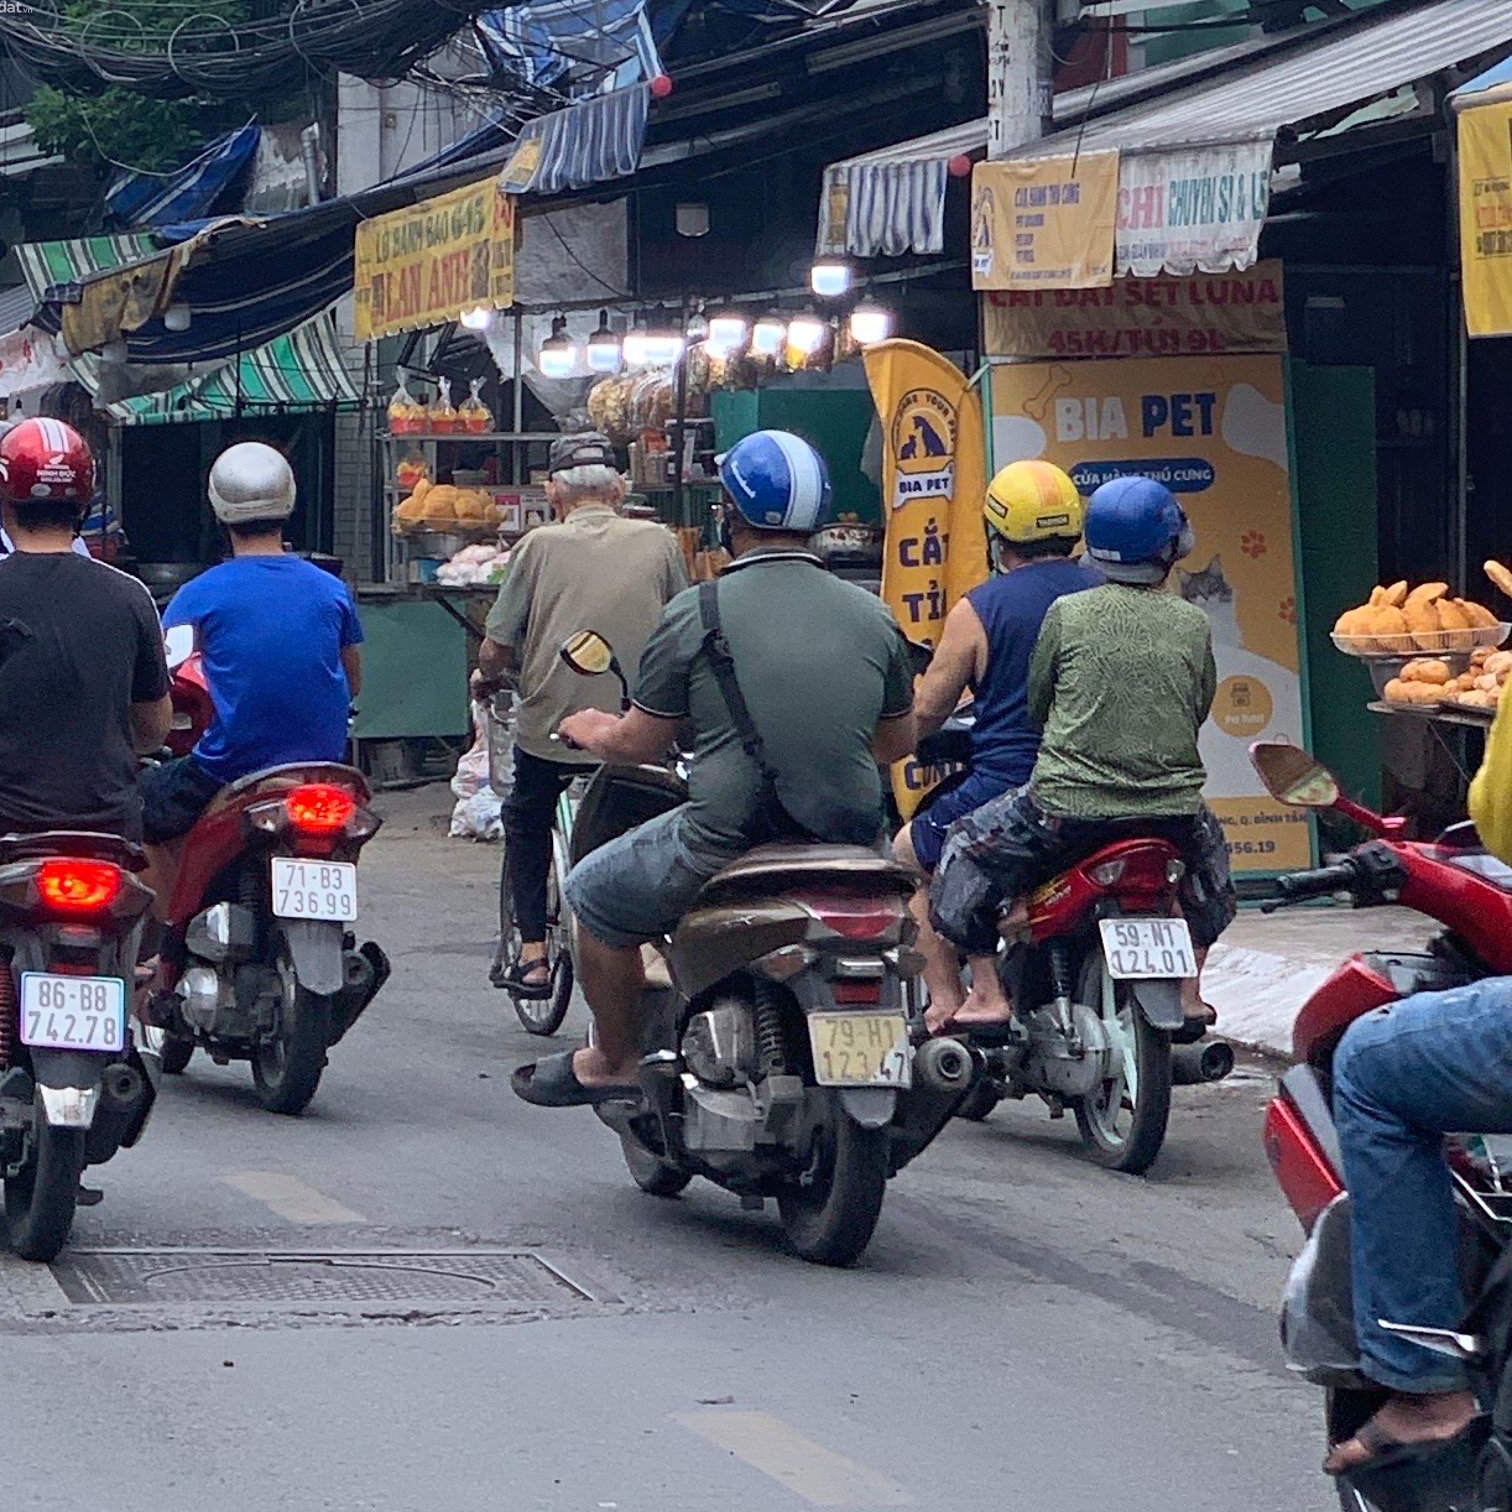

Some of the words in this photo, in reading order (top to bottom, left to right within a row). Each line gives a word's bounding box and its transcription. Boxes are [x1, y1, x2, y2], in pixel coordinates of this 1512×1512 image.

[1189, 278, 1280, 305] LUNA
[1055, 396, 1129, 443] BIA
[1142, 392, 1217, 438] PET
[899, 480, 923, 494] BIA
[926, 477, 950, 491] PET
[901, 579, 947, 623] TỈ
[286, 864, 343, 890] 71-B3
[278, 889, 352, 916] 736.99
[38, 980, 107, 1012] 86-B8
[27, 1011, 117, 1046] 742.78
